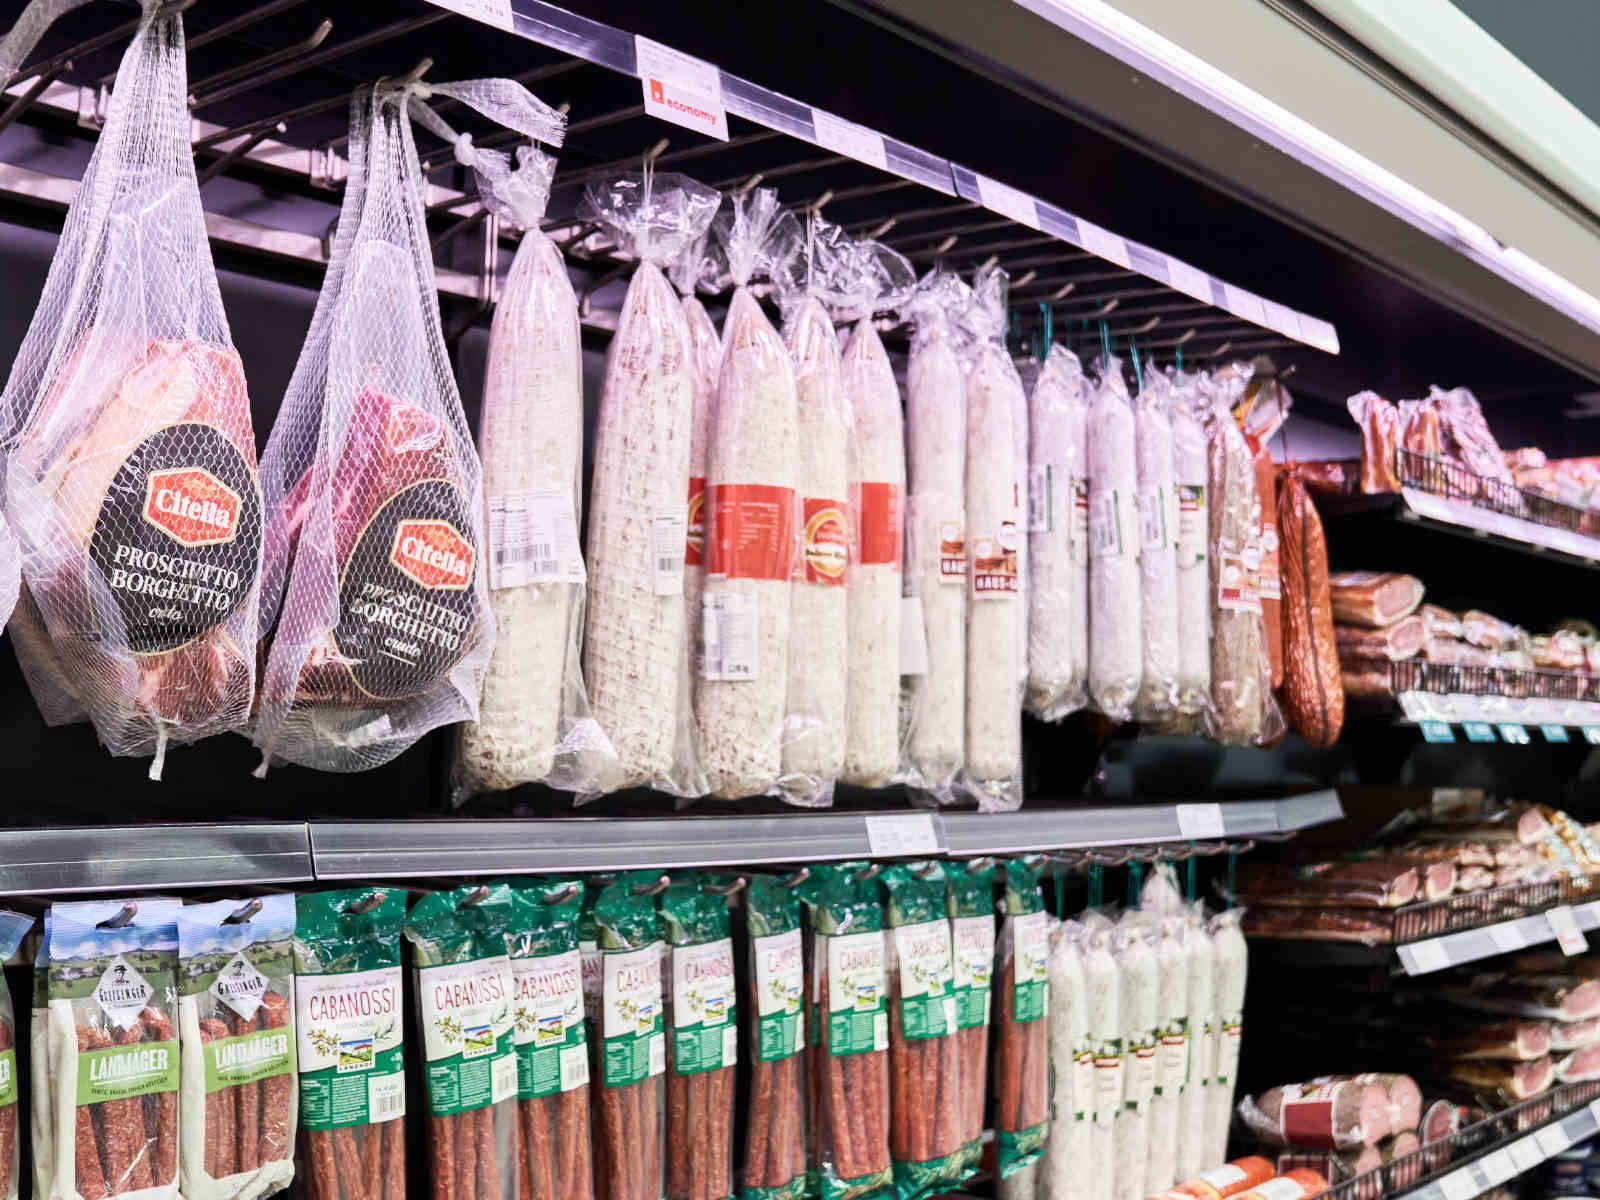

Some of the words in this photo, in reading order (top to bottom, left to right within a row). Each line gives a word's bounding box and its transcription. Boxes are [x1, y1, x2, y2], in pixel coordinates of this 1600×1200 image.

[666, 99, 717, 126] economy
[154, 487, 231, 529] Citella
[401, 536, 466, 577] Citella
[309, 986, 396, 1021] CABANOSSI
[90, 1047, 169, 1081] LANDJÄGER
[214, 1032, 289, 1071] LANDJÄGER
